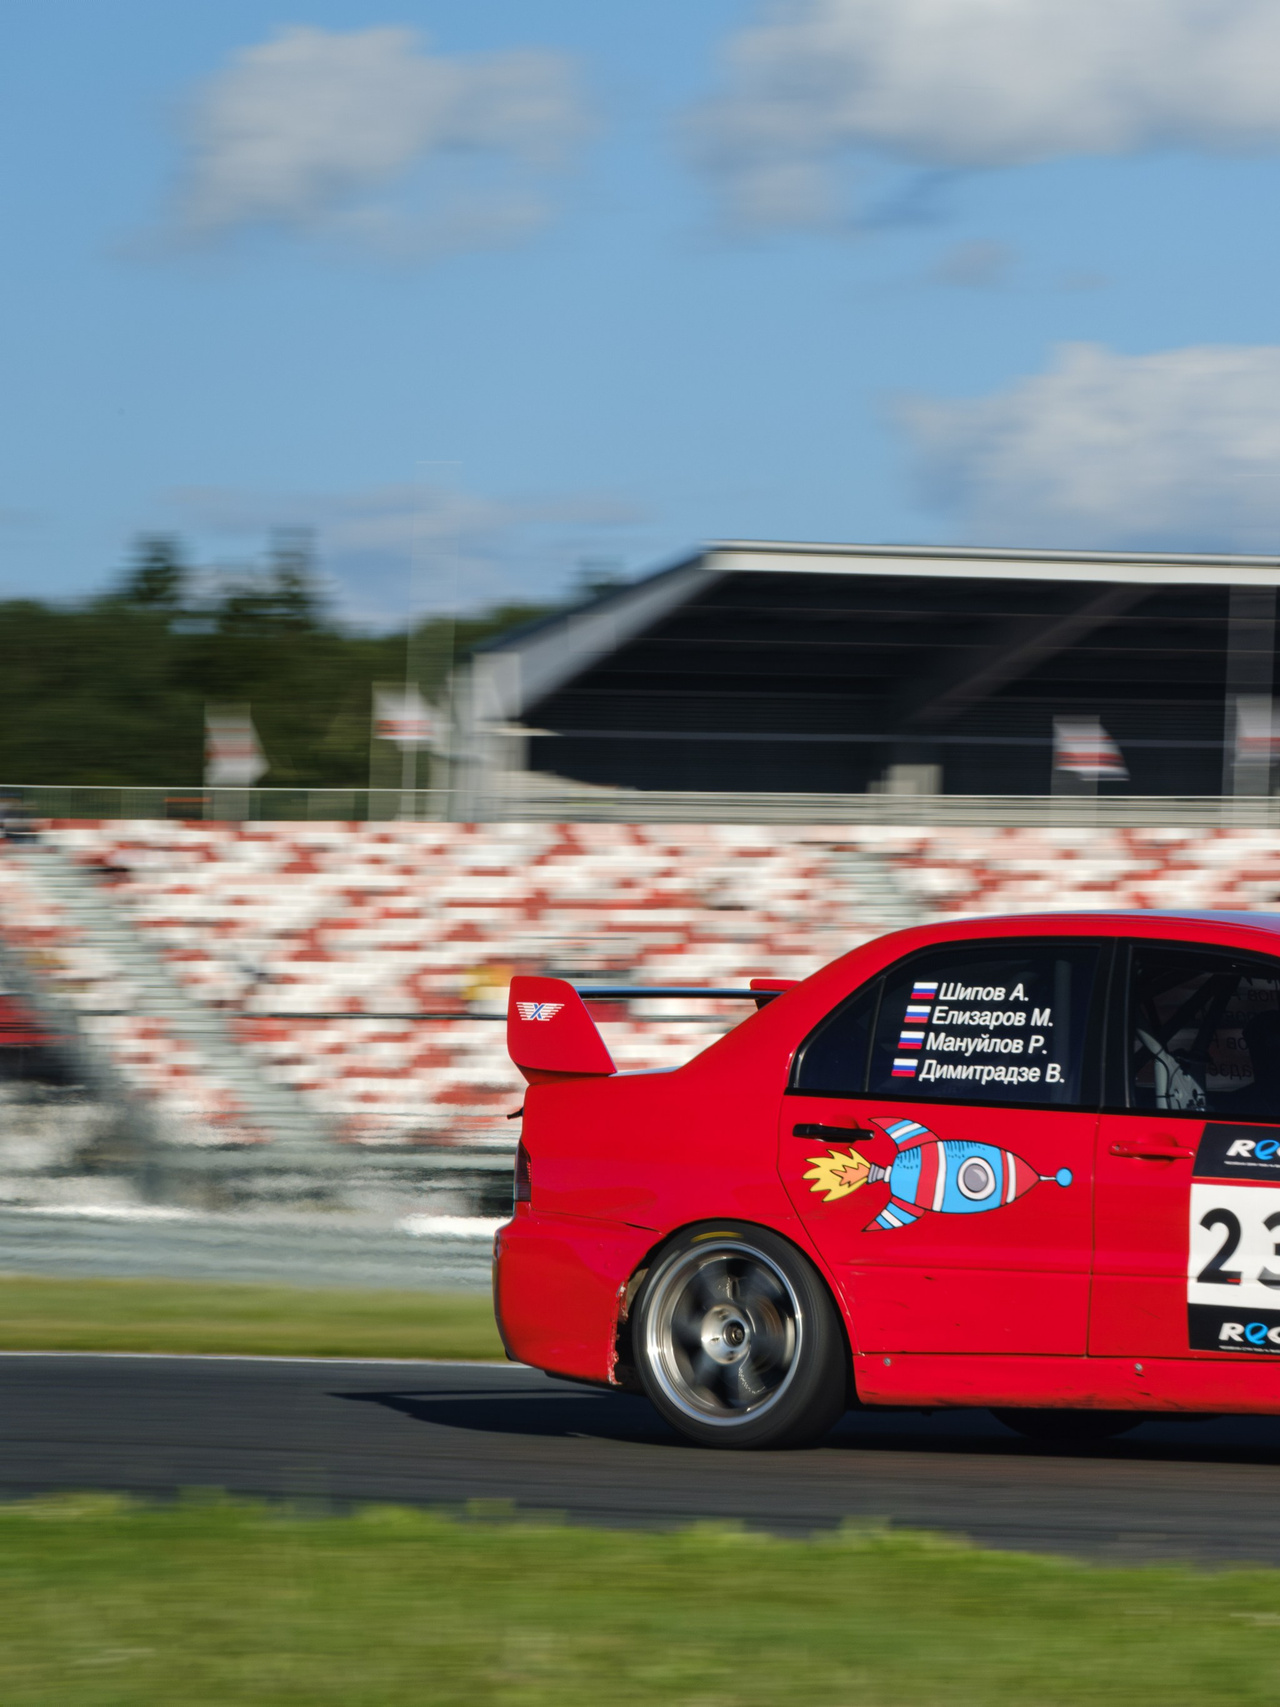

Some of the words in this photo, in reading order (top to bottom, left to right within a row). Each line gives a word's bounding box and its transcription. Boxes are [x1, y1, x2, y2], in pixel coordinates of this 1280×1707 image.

[938, 982, 1006, 1001] Шипов
[1008, 983, 1030, 1001] А.
[932, 1006, 1026, 1030] Елизаров
[1030, 1008, 1054, 1027] М.
[926, 1031, 1024, 1057] Мануйлов
[1028, 1035, 1048, 1055] Р.
[918, 1059, 1041, 1085] Димитрадзе
[1045, 1063, 1066, 1083] В.
